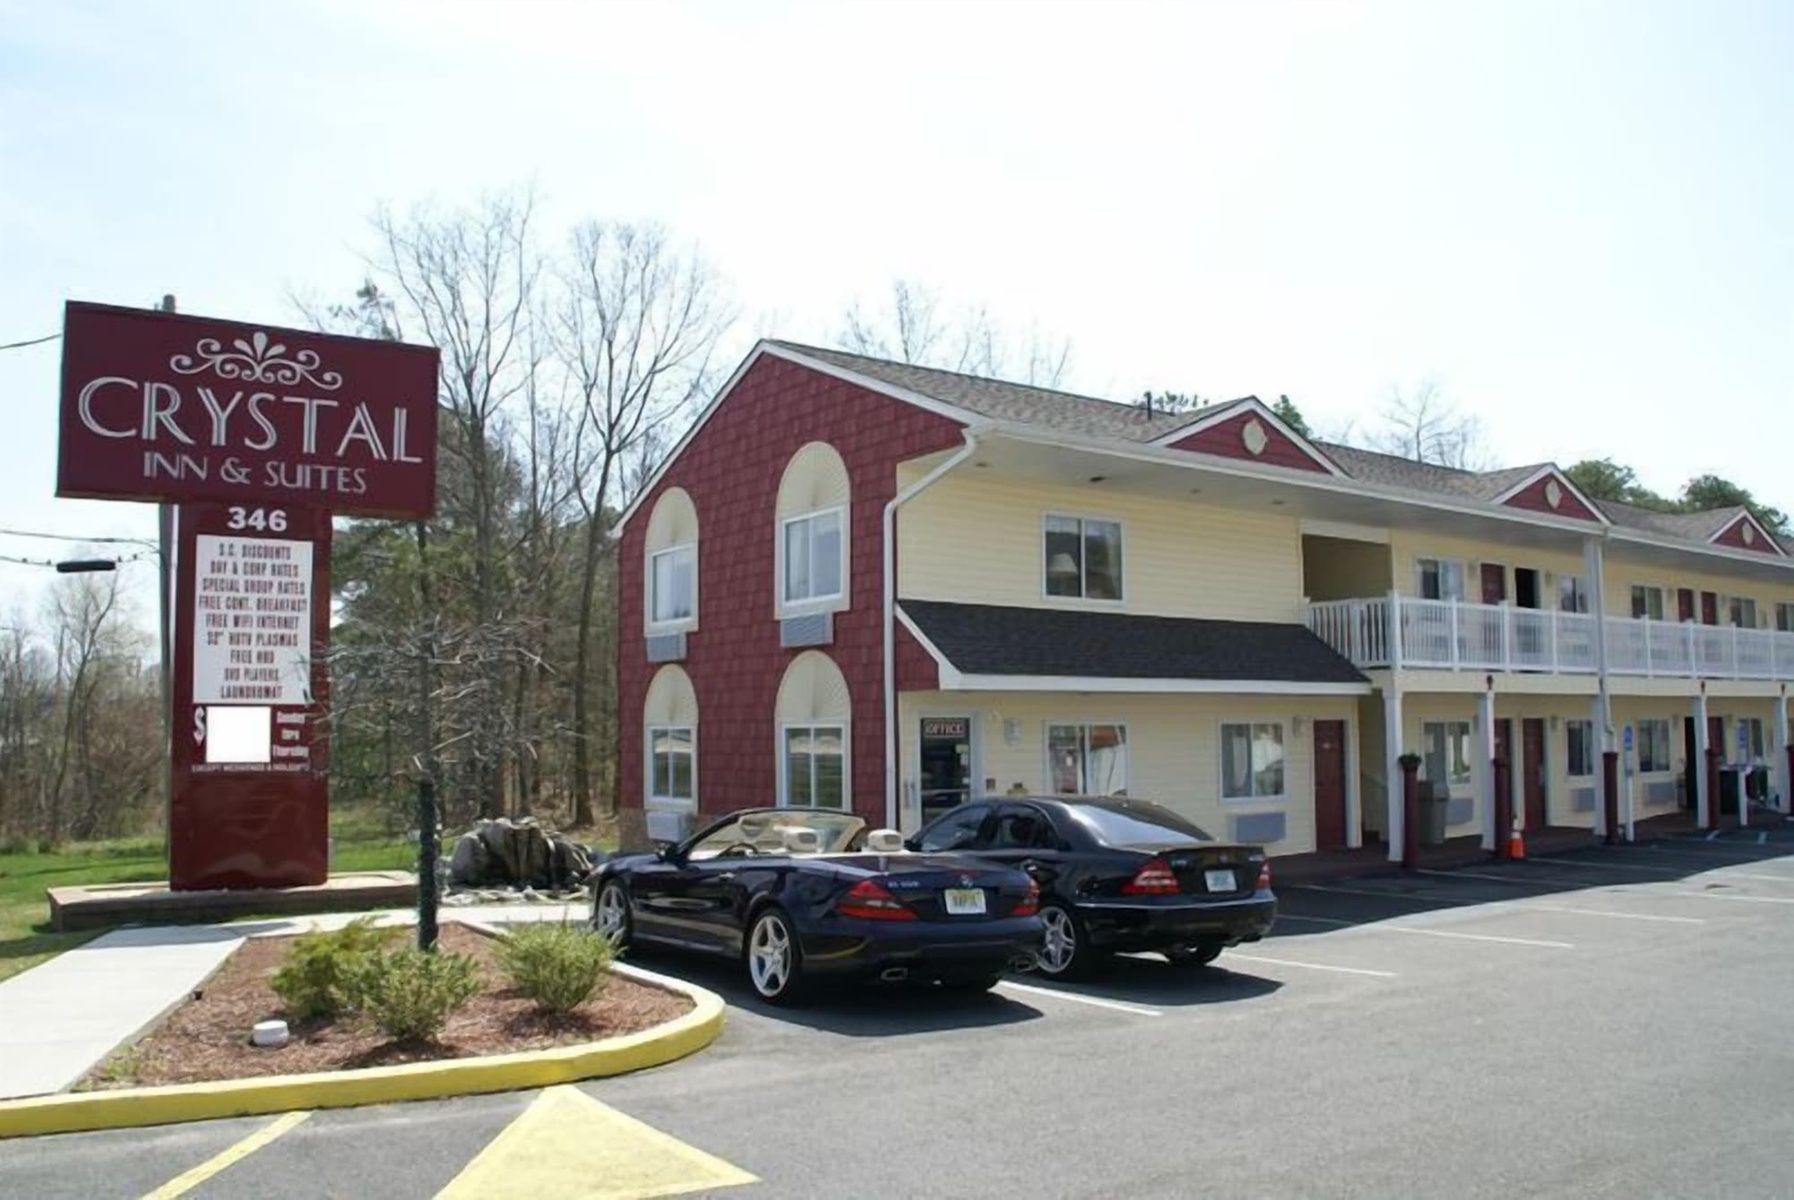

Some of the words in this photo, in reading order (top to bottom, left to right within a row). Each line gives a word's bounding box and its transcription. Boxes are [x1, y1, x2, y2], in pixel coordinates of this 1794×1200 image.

[78, 376, 424, 463] CRYSTAL
[143, 451, 208, 482] INN
[220, 456, 251, 485] &
[264, 460, 367, 493] SUITES
[227, 506, 287, 532] 346
[242, 544, 291, 560] DISCOUNTS
[271, 563, 299, 578] RATES
[203, 578, 240, 592] SPECIAL
[244, 579, 274, 594] GROUP
[278, 580, 305, 595] RATES
[199, 595, 221, 609] FREE
[257, 598, 307, 612] BREAKFAST
[206, 613, 227, 628] FREE
[233, 614, 253, 628] WIFI
[257, 615, 299, 629] INTERNET
[229, 632, 252, 646] HDTV
[256, 633, 298, 647] PLASMAS
[230, 650, 252, 664] FREE
[244, 668, 279, 681] PLAYERS
[221, 685, 282, 699] LAUNDROMAT
[925, 722, 965, 734] OFFICE
